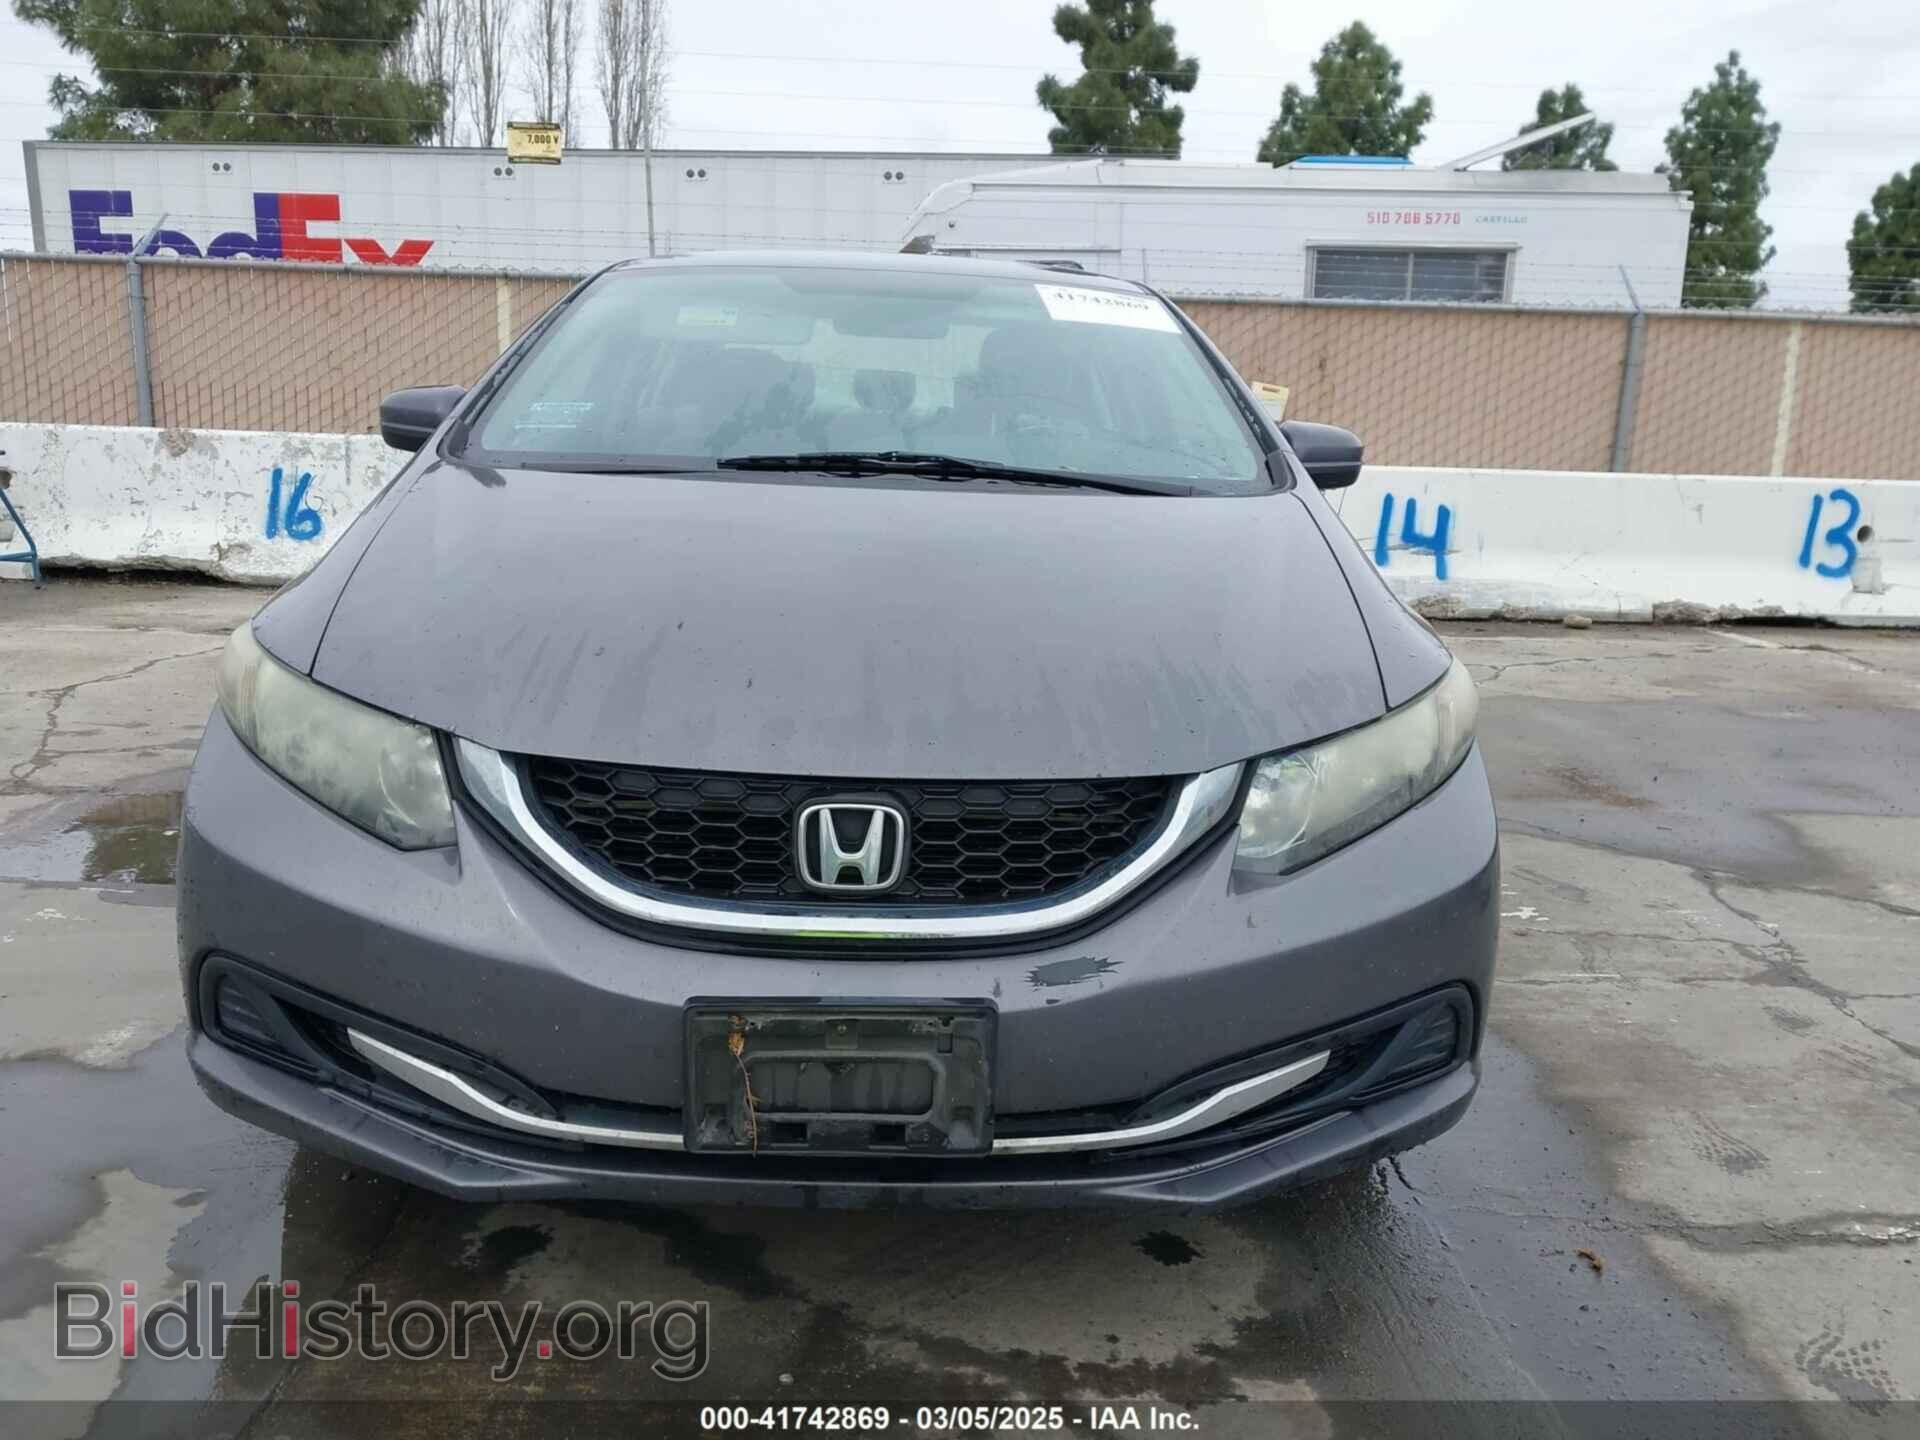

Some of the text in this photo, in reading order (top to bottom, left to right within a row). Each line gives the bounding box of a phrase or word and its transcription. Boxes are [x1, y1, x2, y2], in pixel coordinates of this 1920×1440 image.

[1367, 211, 1390, 224] 510
[1424, 211, 1461, 225] 5770
[266, 467, 323, 541] 16
[1374, 492, 1451, 582] 14
[1799, 488, 1860, 578] 13
